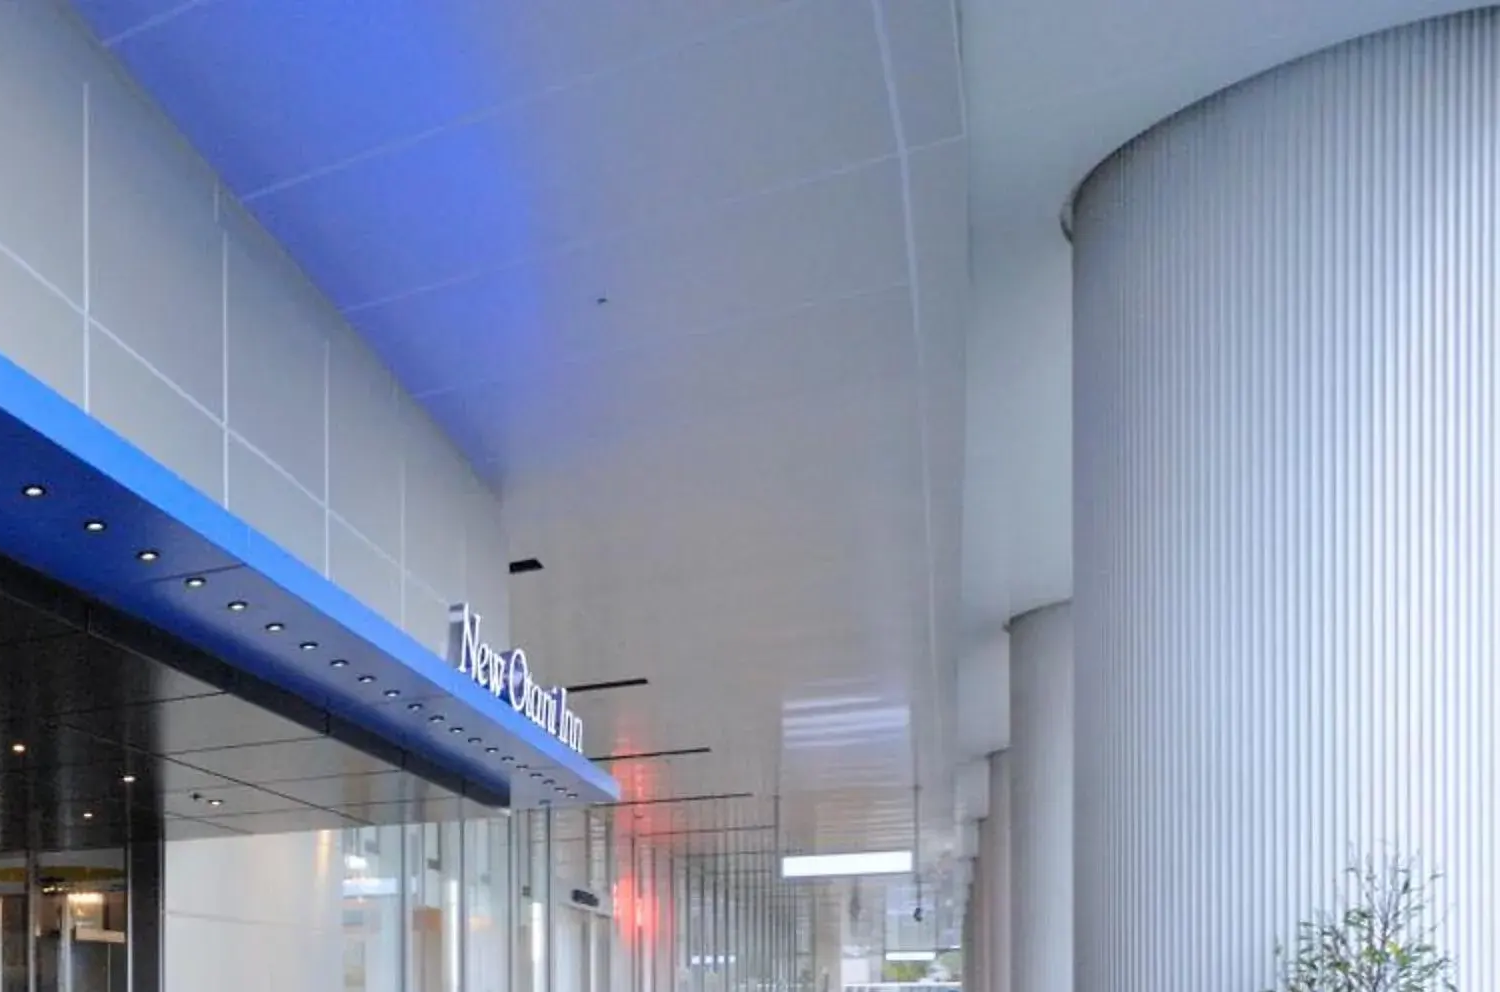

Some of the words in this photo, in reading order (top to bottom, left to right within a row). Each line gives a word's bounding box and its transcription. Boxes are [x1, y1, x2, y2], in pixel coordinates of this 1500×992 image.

[458, 602, 506, 697] New
[508, 648, 558, 736] Otani
[558, 687, 584, 754] Inn
